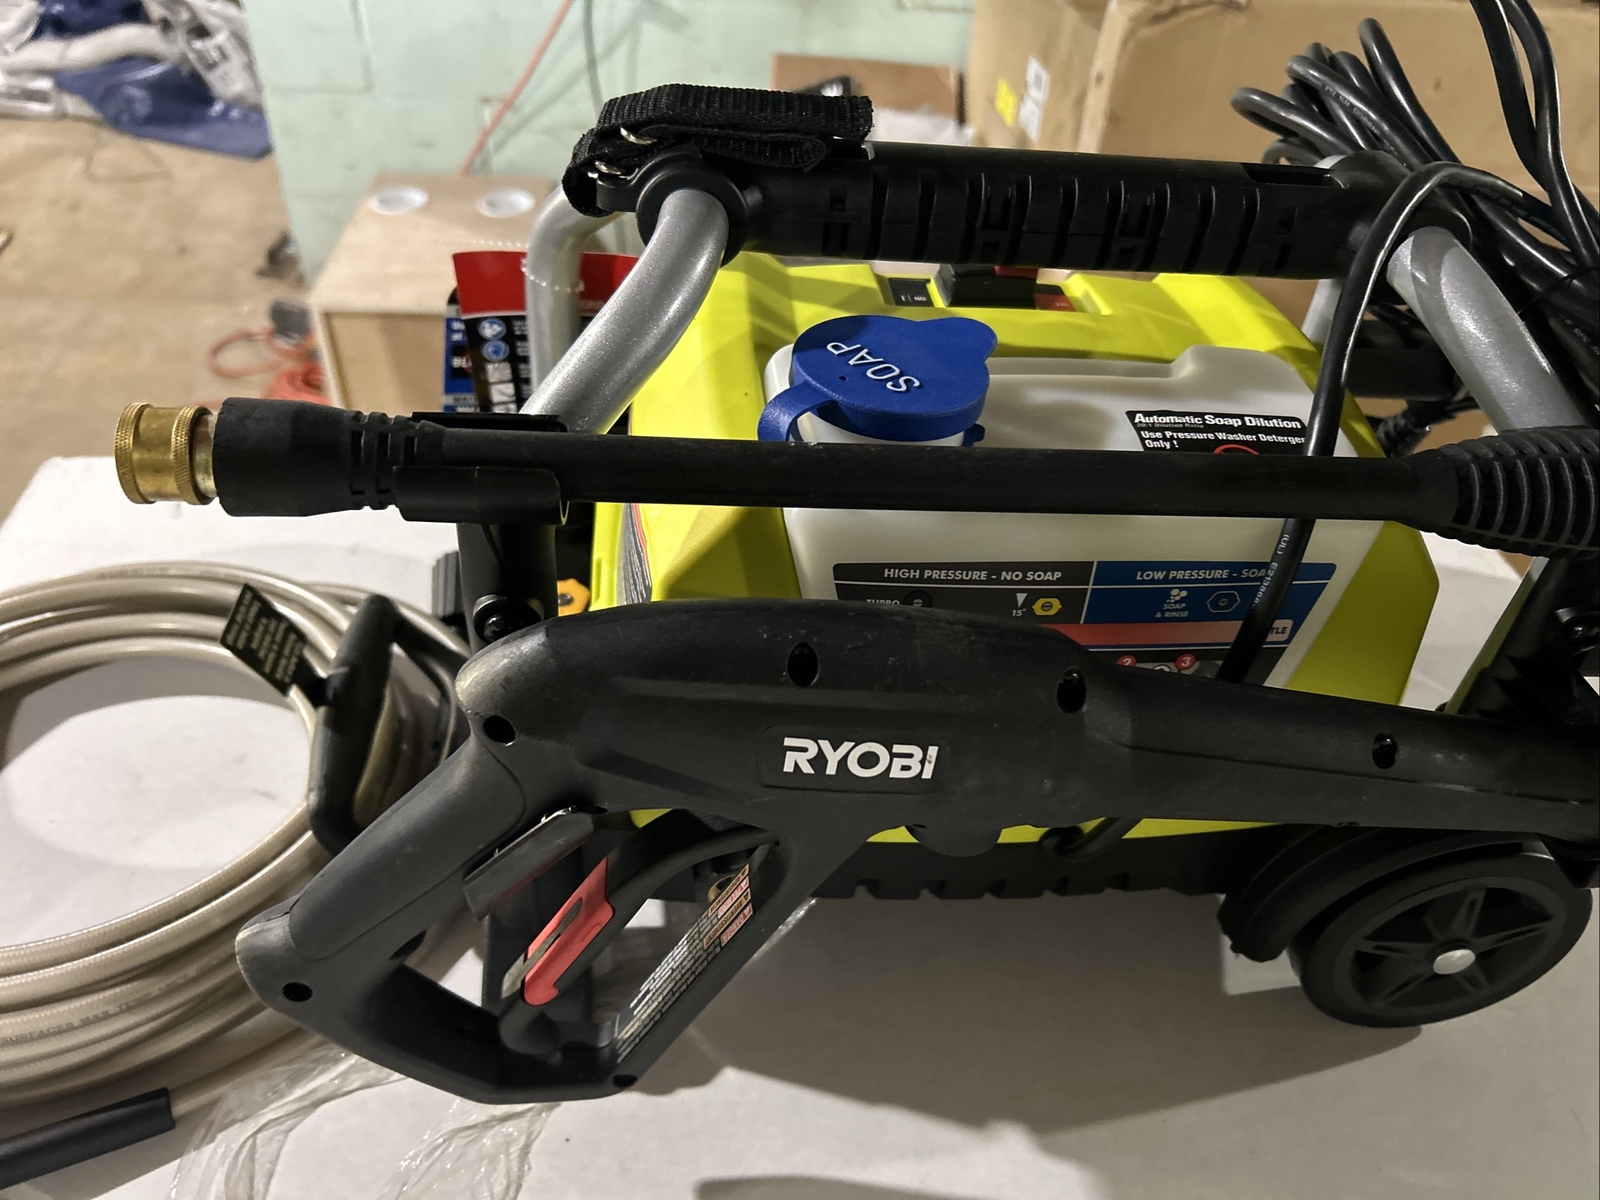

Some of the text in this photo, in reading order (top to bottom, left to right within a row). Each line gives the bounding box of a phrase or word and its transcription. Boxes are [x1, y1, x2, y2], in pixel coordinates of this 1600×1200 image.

[826, 341, 921, 393] SOAP
[1134, 413, 1301, 429] Automatic Soap Dilution
[1140, 430, 1163, 439] Use
[1166, 431, 1215, 440] Pressure
[1215, 432, 1257, 442] Washer
[1145, 439, 1171, 449] Only
[884, 568, 920, 579] HIGH
[924, 569, 988, 581] PRESSURE
[1000, 571, 1024, 581] NO
[1026, 571, 1062, 582] SOAP
[1136, 570, 1165, 580] LOW
[1168, 569, 1228, 580] PRESSURE
[1241, 569, 1267, 578] SOA
[1180, 656, 1191, 667] 3
[783, 737, 939, 779] RYOBI
